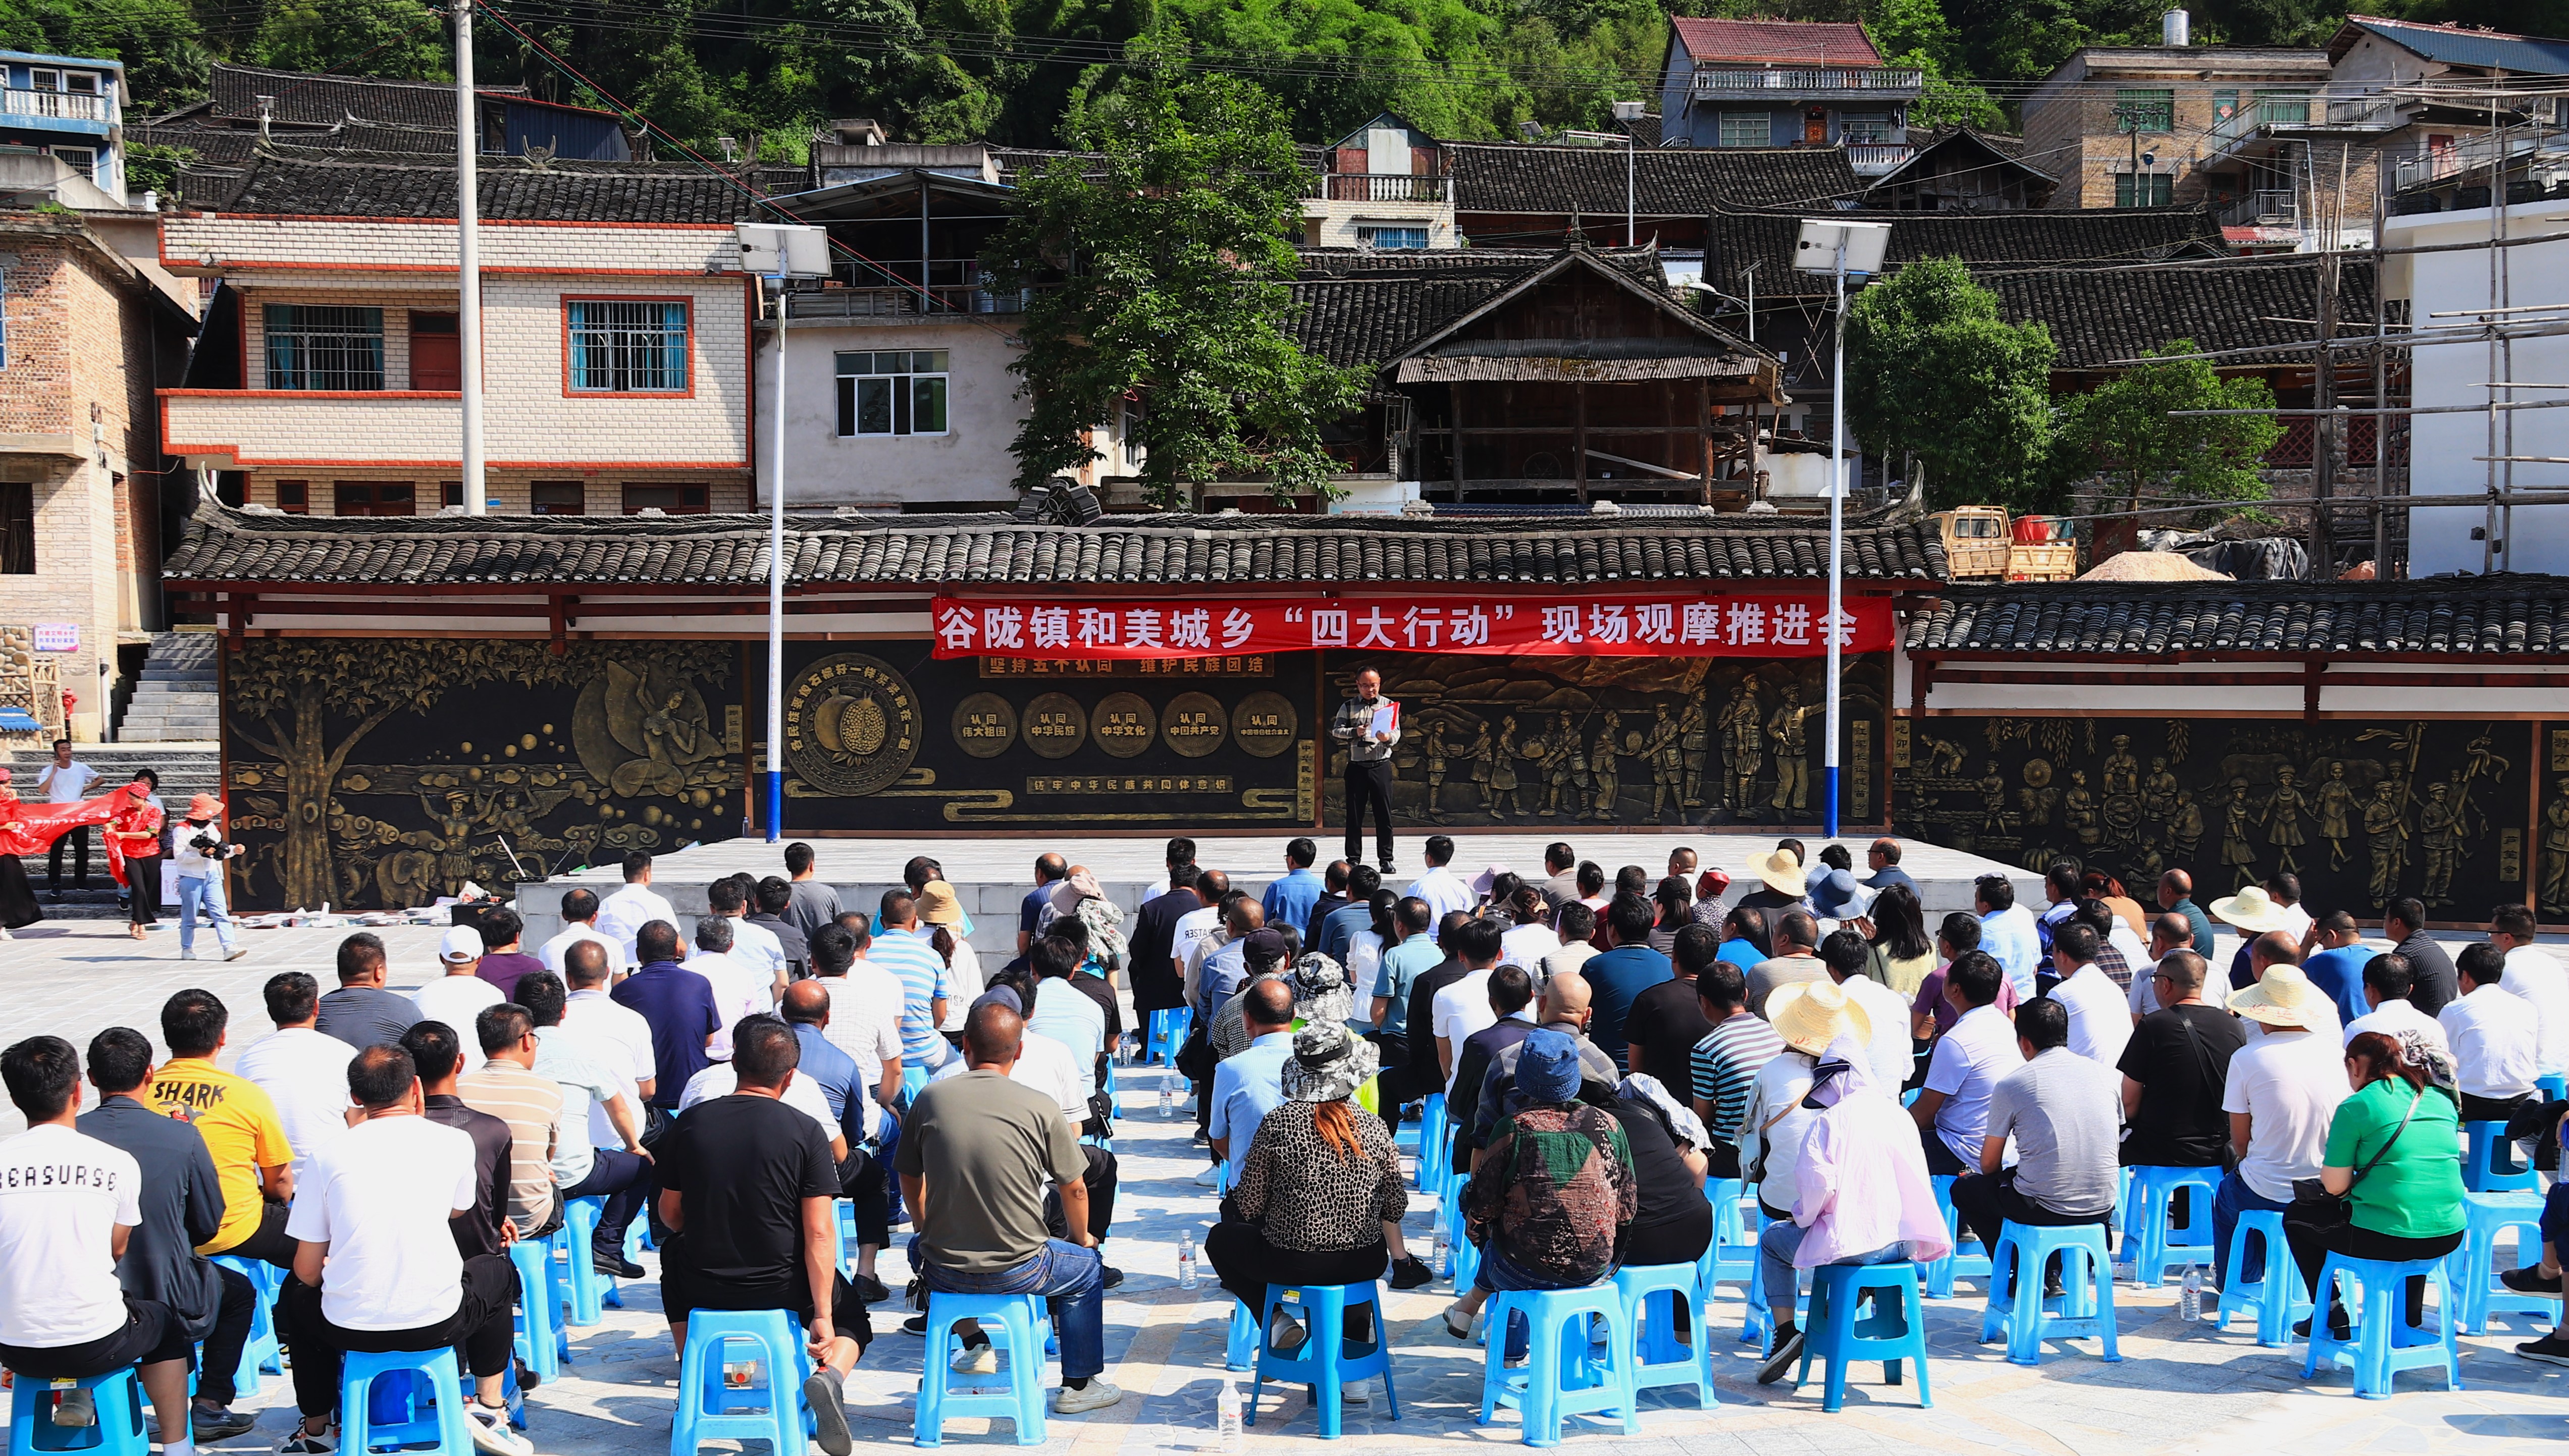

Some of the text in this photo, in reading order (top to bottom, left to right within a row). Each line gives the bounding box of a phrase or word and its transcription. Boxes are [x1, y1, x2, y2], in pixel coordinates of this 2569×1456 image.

[939, 602, 1857, 649] 谷陇镇和美城乡 “四大行动” 现场观摩推进会
[990, 657, 1263, 674] 坚持五个认同 维护民族团结
[971, 714, 997, 724] 认同
[1040, 713, 1066, 724] 认同
[1110, 713, 1136, 723] 认同
[1180, 713, 1206, 723] 认同
[1251, 715, 1277, 726] 认同
[963, 726, 1006, 737] 伟大祖国
[1031, 726, 1076, 736] 中华民族
[1102, 726, 1146, 736] 中华文化
[1170, 726, 1220, 735] 中国共产党
[1895, 725, 1909, 762] 吃卯节
[2553, 737, 2569, 764] 游方
[1854, 728, 1867, 811] 红军长征过苗乡
[1035, 780, 1226, 790] 铸牢中华民族共同体意识
[1301, 745, 1312, 816] 中华民族一家亲
[2503, 835, 2518, 874] 芦笙会
[154, 1082, 227, 1109] SHARK
